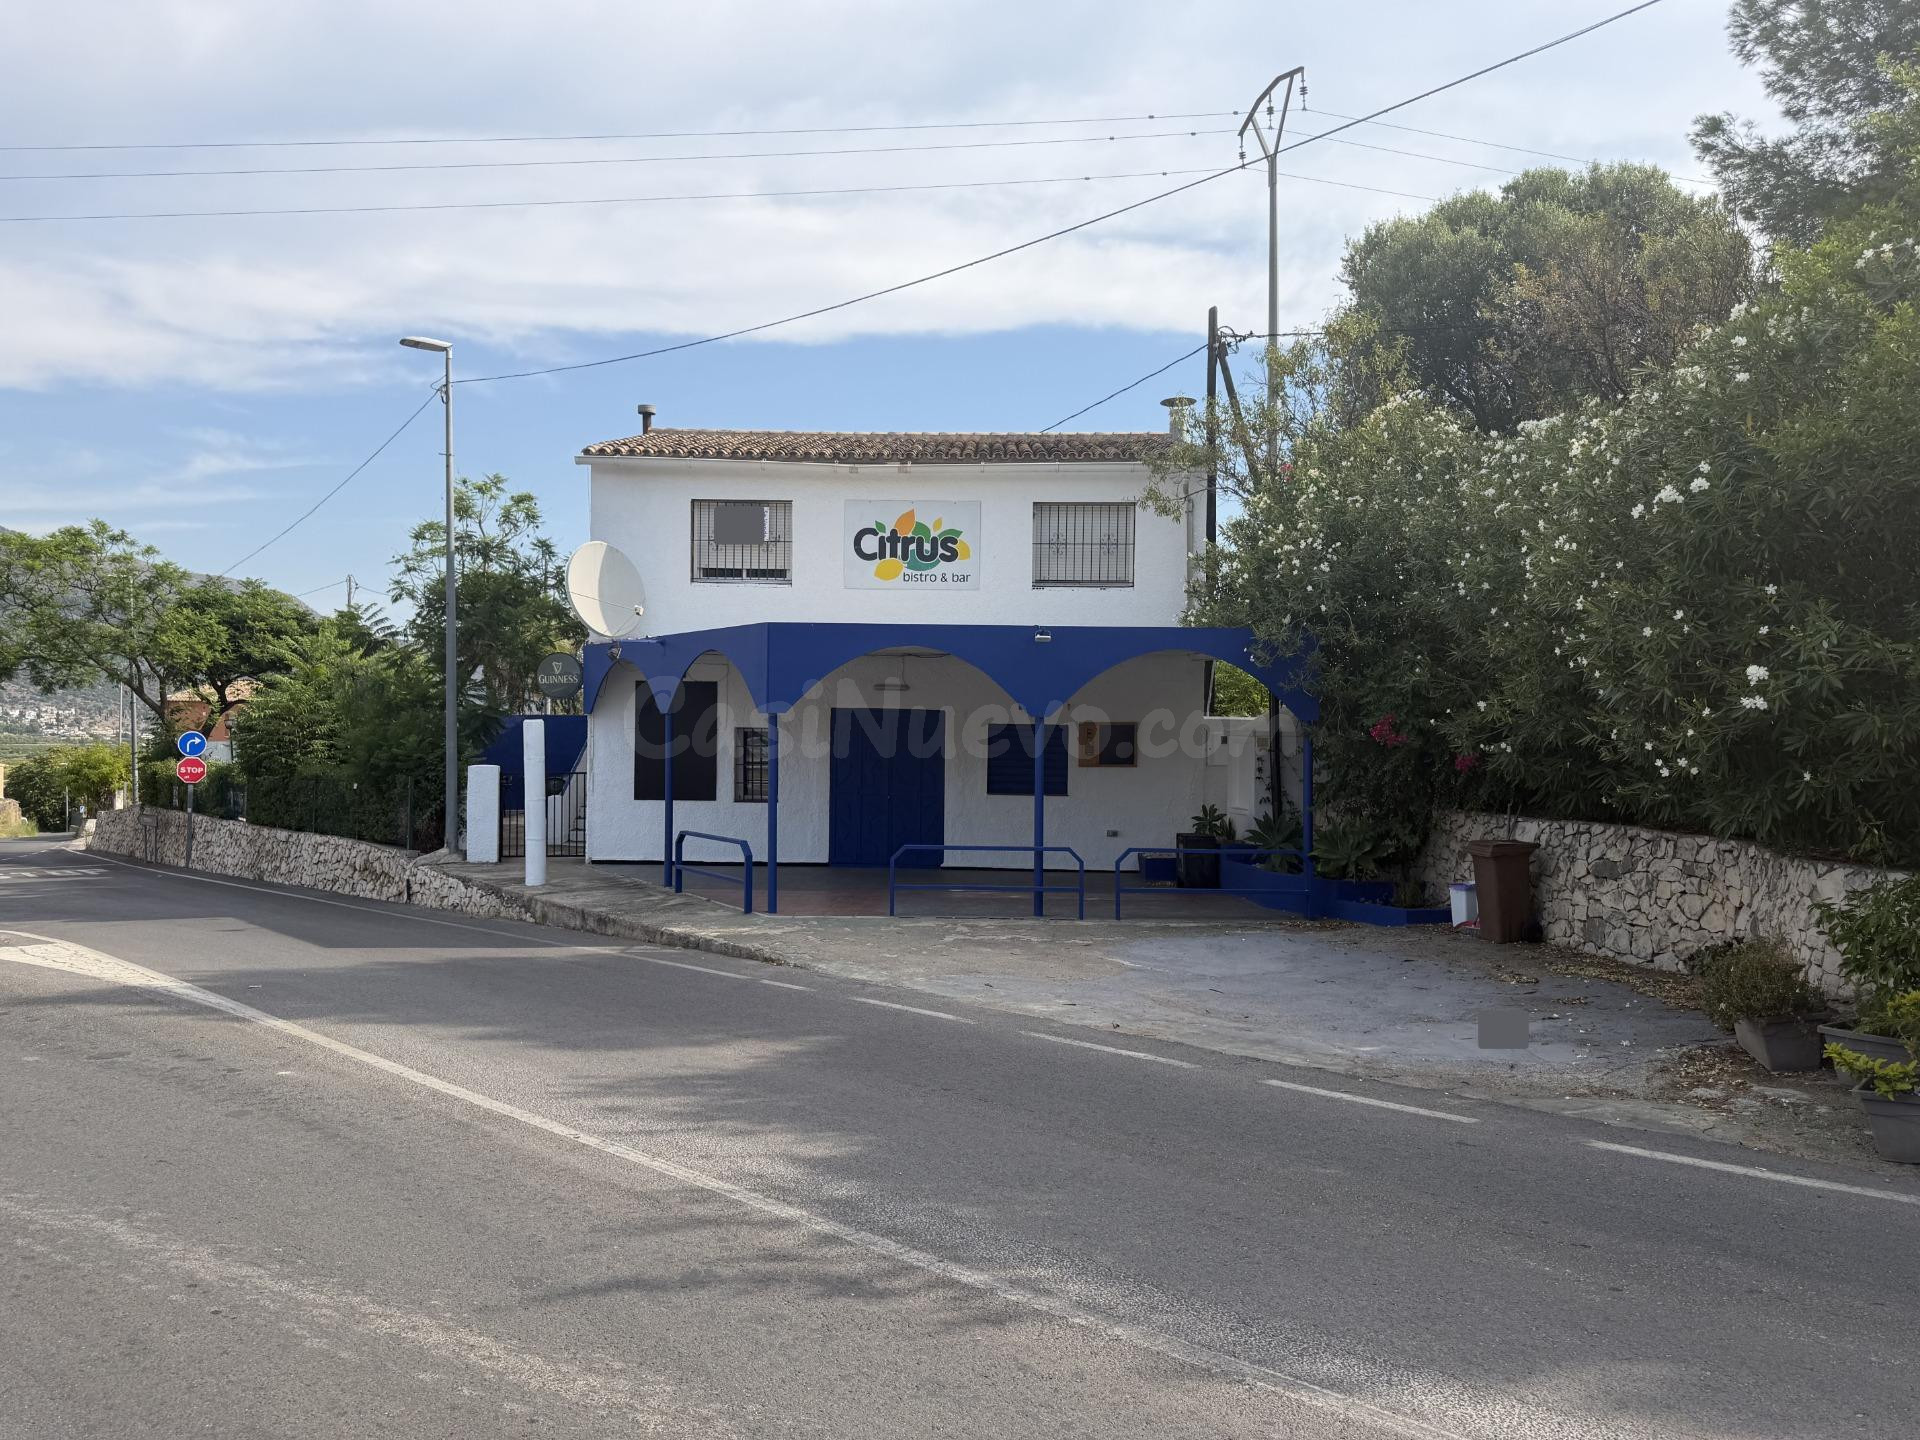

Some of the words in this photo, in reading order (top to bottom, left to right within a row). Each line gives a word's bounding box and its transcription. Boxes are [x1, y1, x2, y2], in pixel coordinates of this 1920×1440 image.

[854, 527, 959, 562] Citrus
[903, 572, 937, 582] bistro
[941, 573, 948, 582] &
[952, 572, 971, 582] bar
[538, 675, 578, 684] GUINNESS
